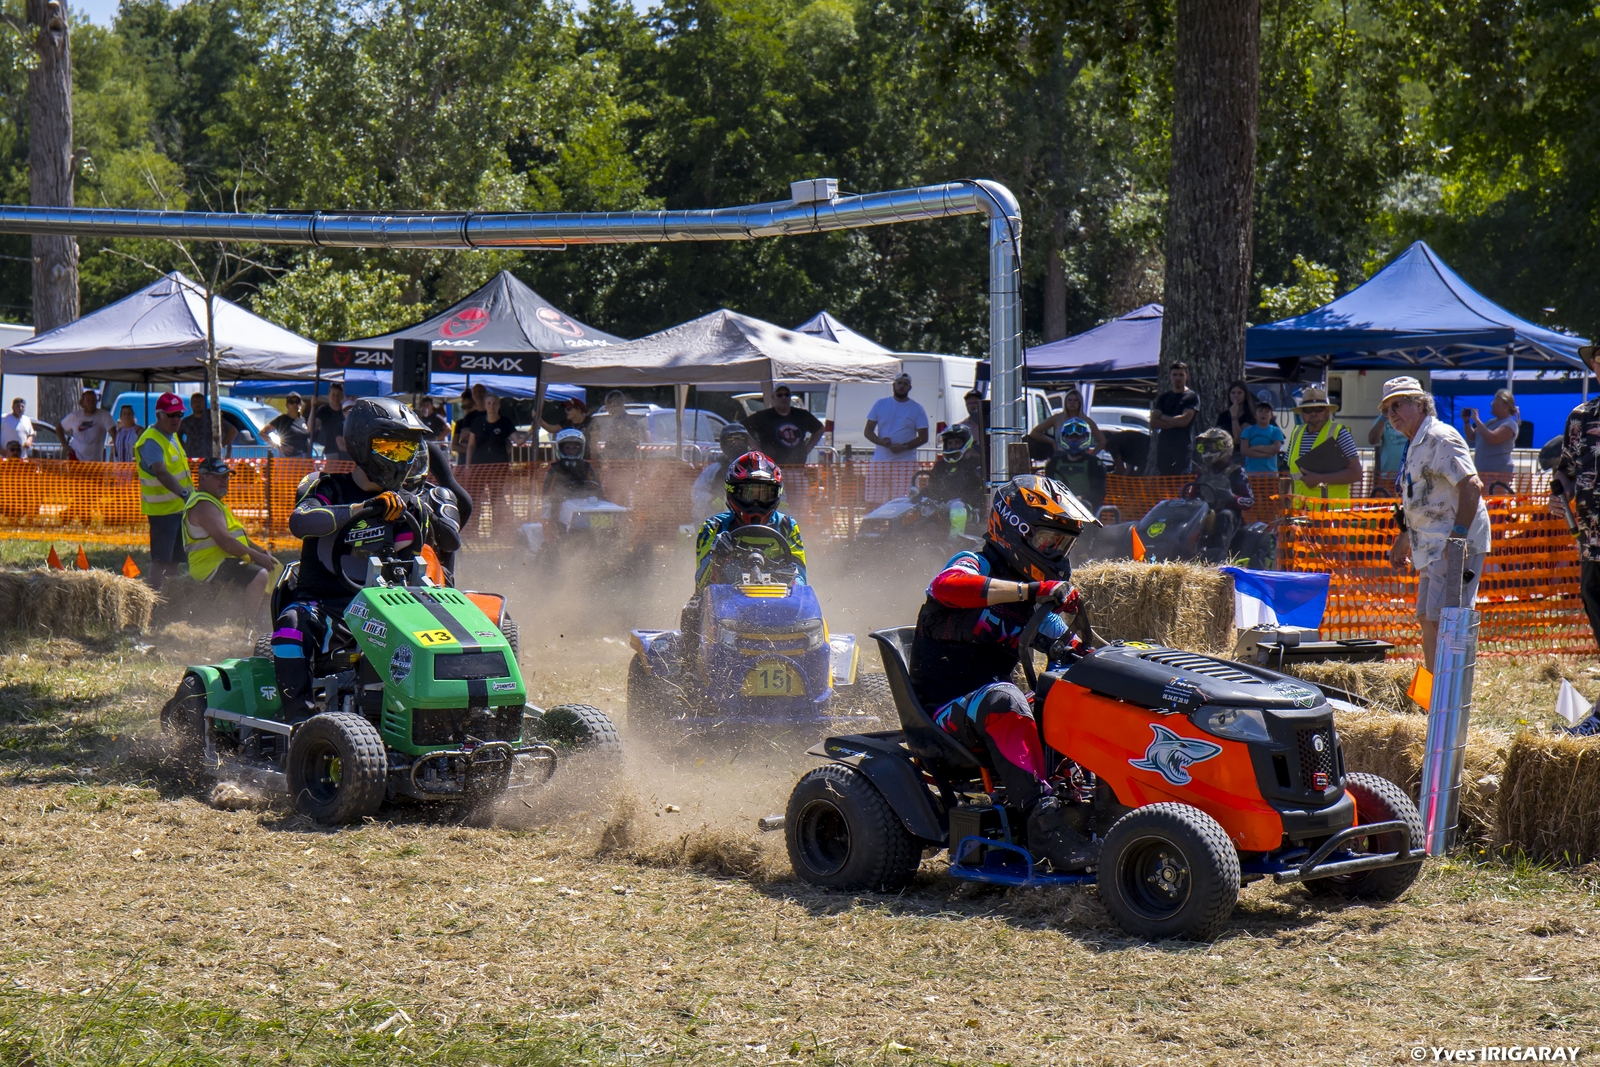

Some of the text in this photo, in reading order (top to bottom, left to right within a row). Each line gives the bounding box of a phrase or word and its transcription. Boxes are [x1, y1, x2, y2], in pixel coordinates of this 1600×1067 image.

[354, 351, 393, 365] 24M
[461, 355, 523, 372] 24MX
[995, 500, 1030, 536] AMOQ
[346, 526, 385, 541] KENNY
[369, 623, 387, 638] BEAL
[421, 632, 451, 643] 13
[760, 670, 785, 689] 15
